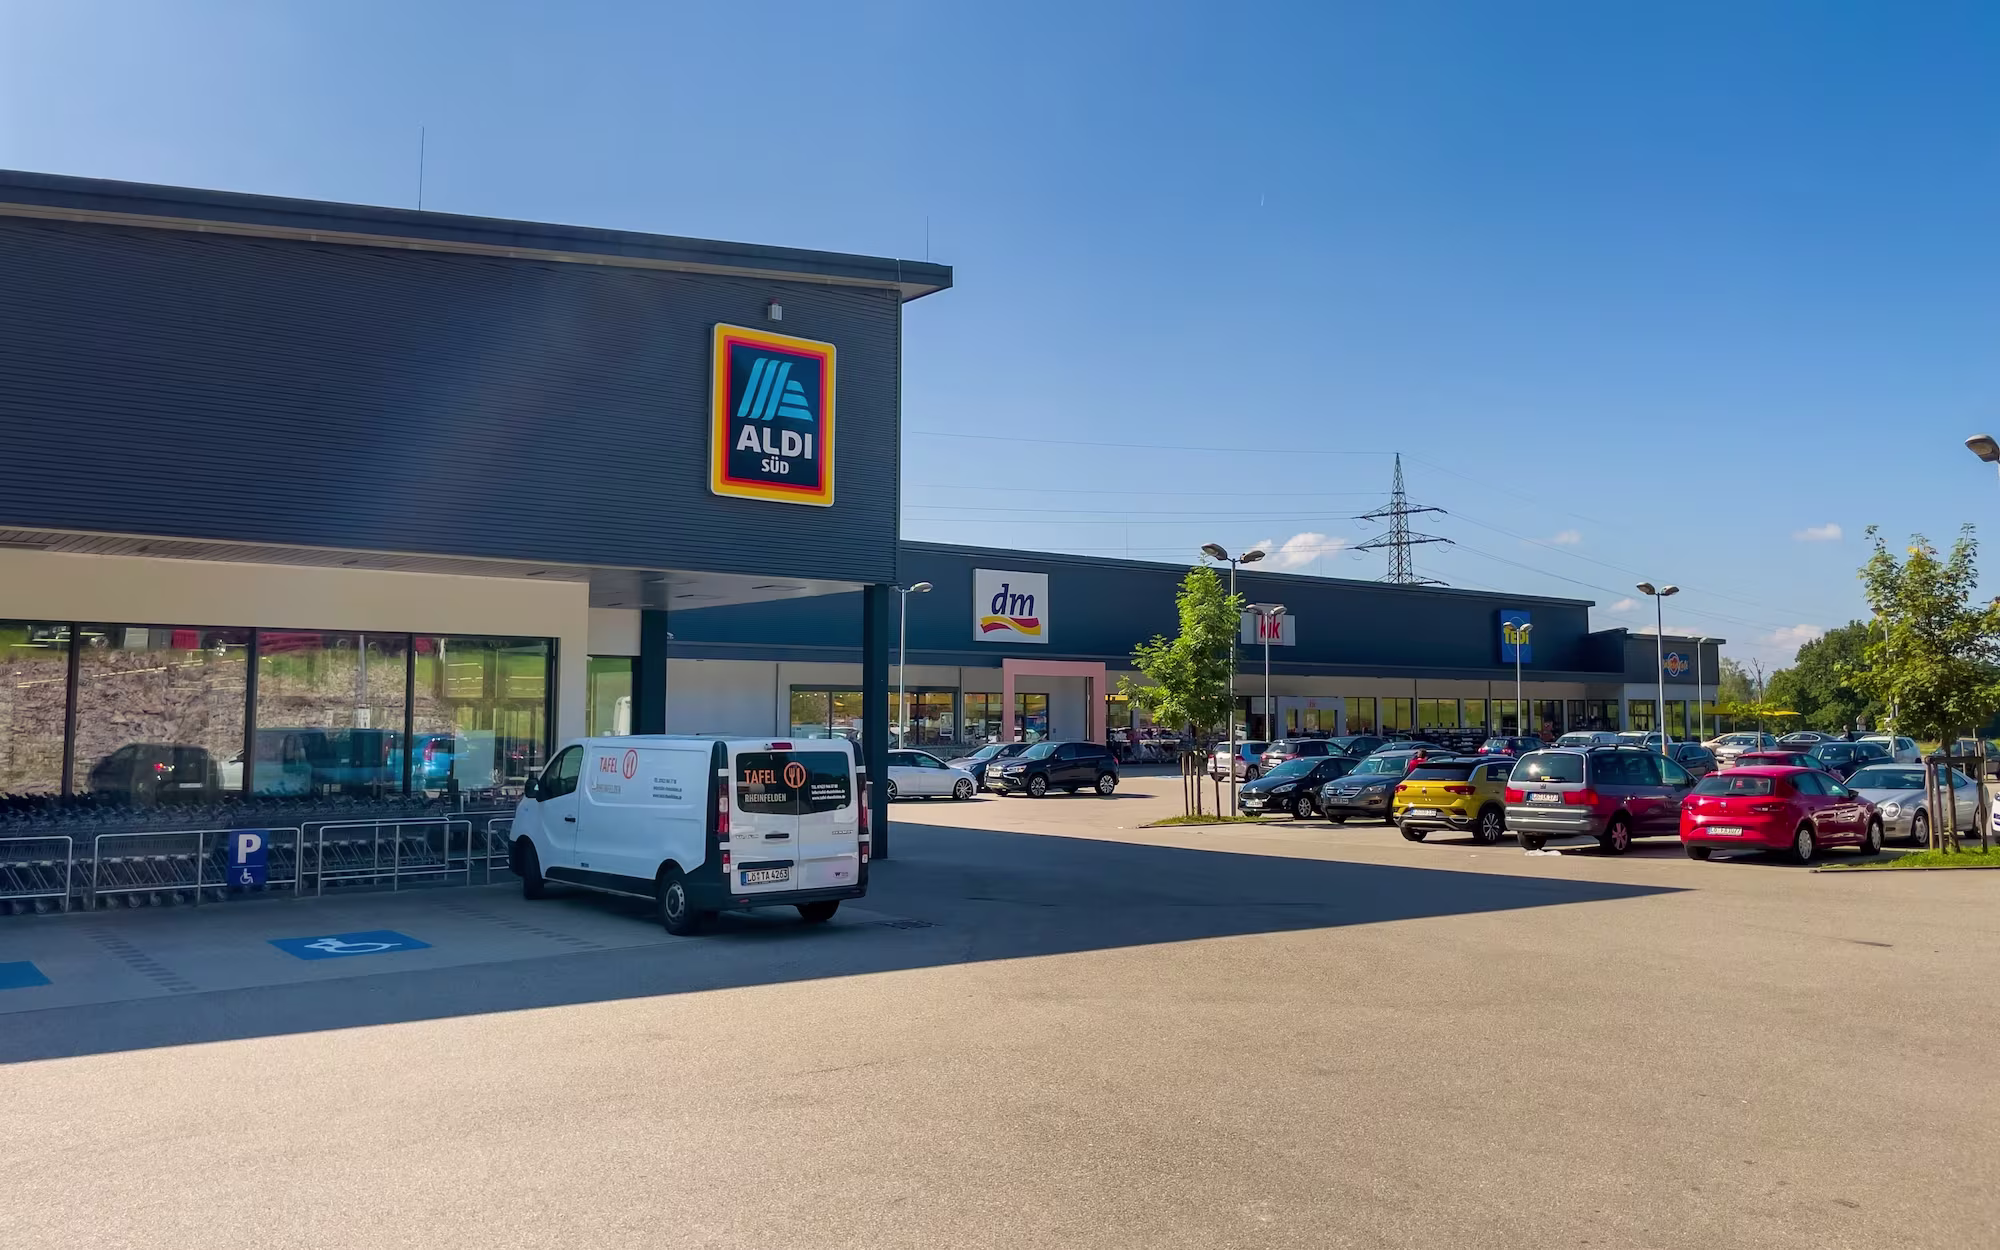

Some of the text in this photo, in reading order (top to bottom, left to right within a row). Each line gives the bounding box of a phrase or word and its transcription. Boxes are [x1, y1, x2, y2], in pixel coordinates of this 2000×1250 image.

[736, 424, 813, 460] ALDI
[761, 456, 790, 475] SÜD
[991, 583, 1035, 616] dm
[599, 757, 618, 773] TAFEL
[743, 769, 777, 785] TAFEL
[744, 793, 787, 803] RHEINFELDEN
[237, 833, 262, 864] P
[760, 871, 770, 880] TA
[771, 869, 788, 879] 4263
